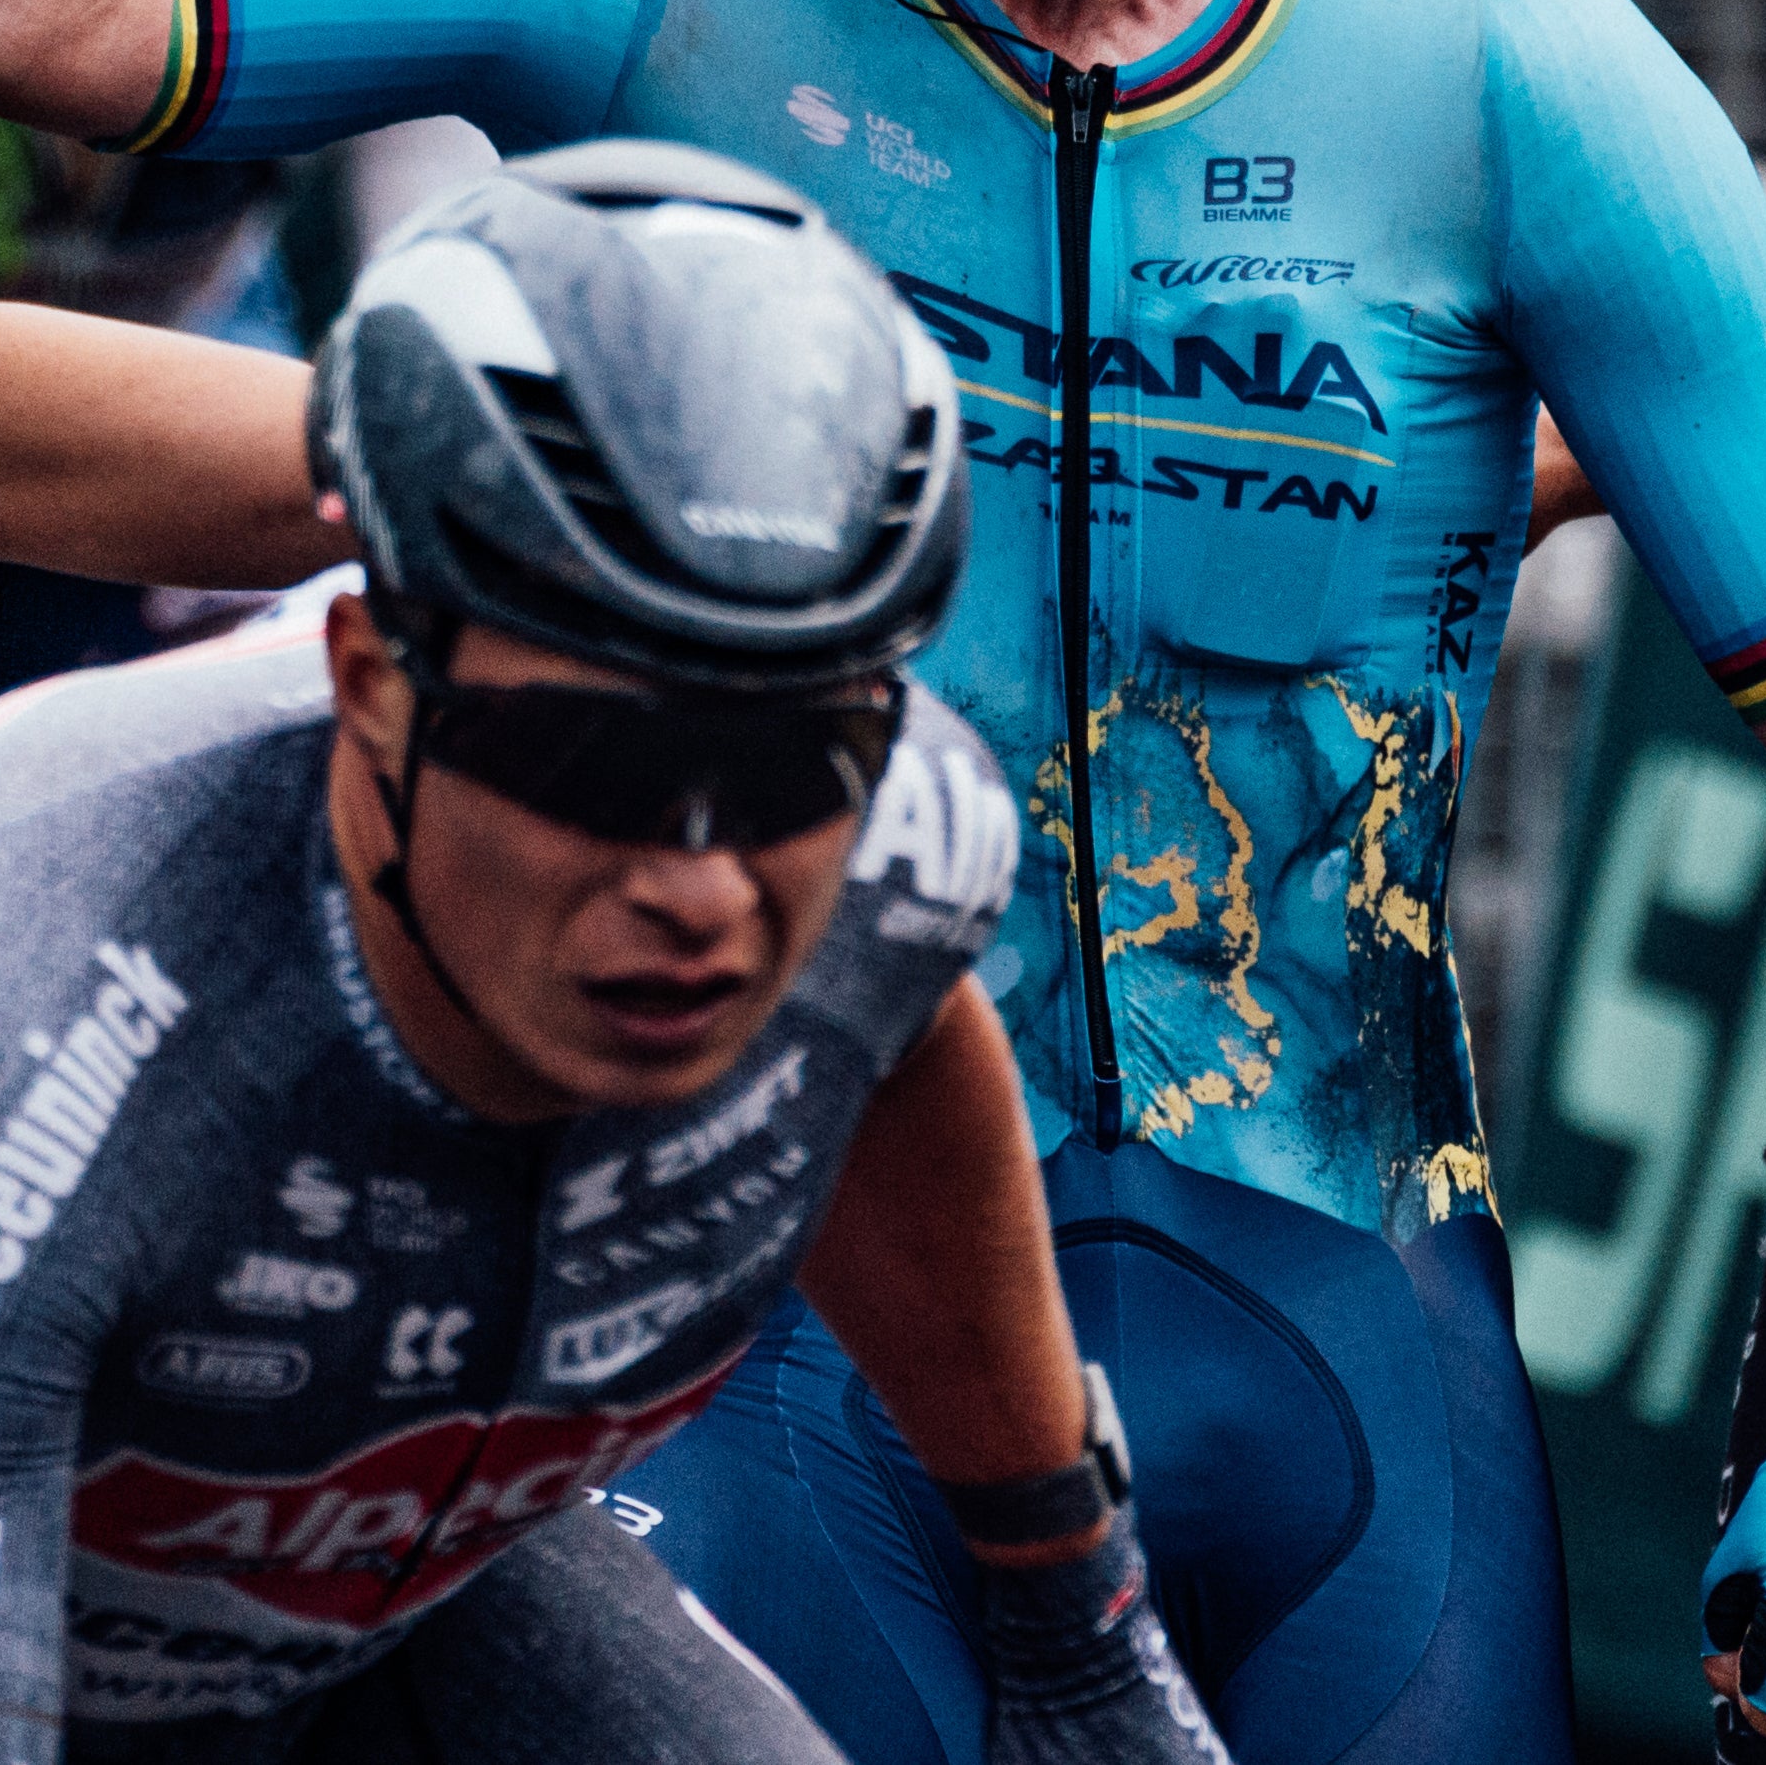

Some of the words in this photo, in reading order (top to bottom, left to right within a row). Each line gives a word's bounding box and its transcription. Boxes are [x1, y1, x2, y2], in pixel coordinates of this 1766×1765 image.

[865, 110, 914, 146] UCI
[865, 130, 952, 180] WORLD
[868, 150, 932, 188] TEAM
[1203, 156, 1296, 206] B3
[1203, 208, 1292, 222] BIEMME
[1130, 254, 1355, 290] Wilier
[885, 271, 1389, 436] STANA
[1037, 500, 1132, 527] TAM
[1437, 532, 1496, 674] KAZ
